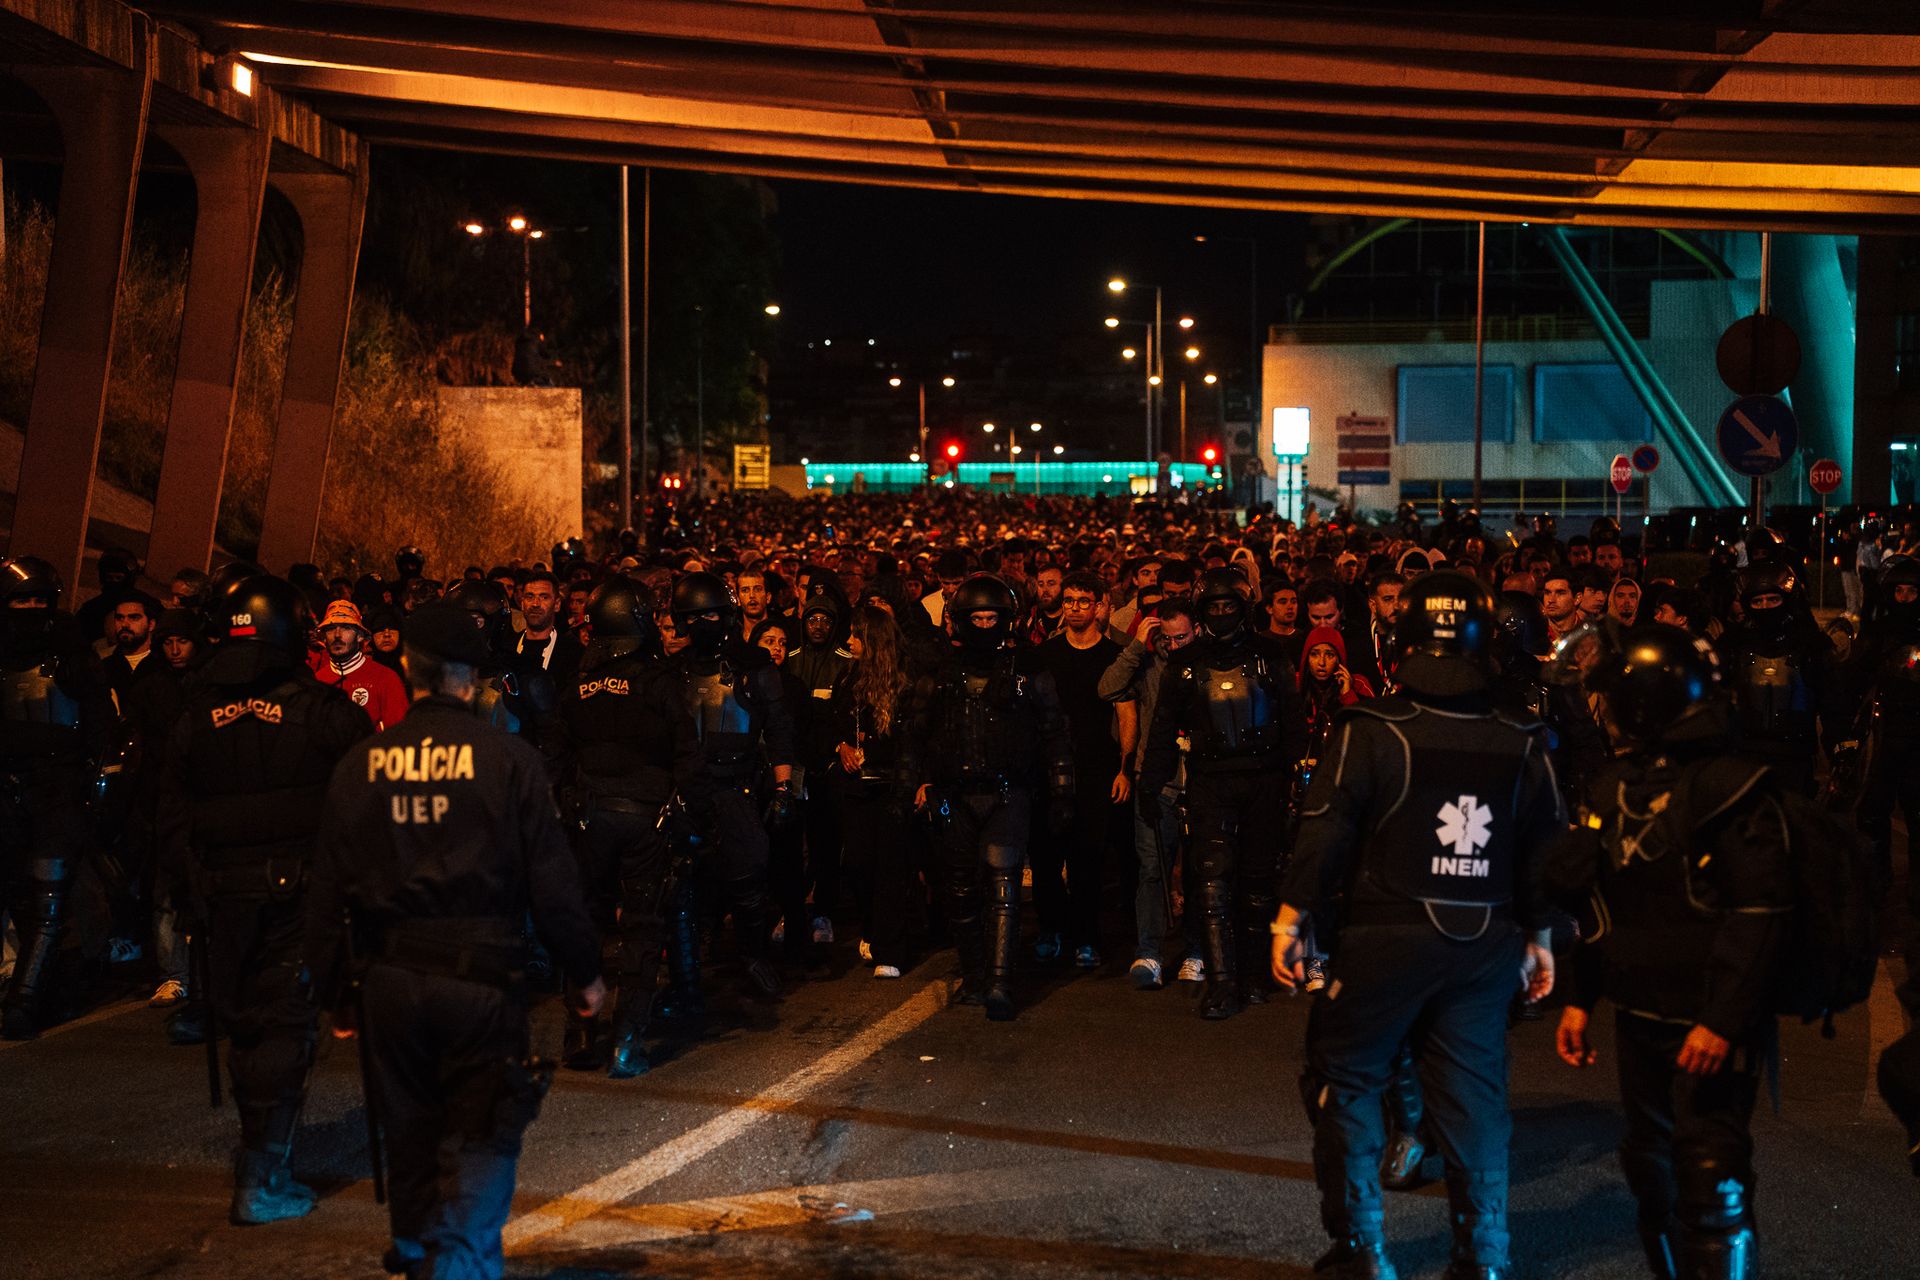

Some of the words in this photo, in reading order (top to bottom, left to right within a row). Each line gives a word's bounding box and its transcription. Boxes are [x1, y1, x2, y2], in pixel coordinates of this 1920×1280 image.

[1812, 470, 1842, 484] STOP
[1425, 597, 1467, 611] INEM
[231, 613, 252, 625] 160
[1436, 612, 1455, 625] 4.1
[368, 736, 475, 783] POLÍCIA
[391, 794, 450, 825] UEP
[1431, 856, 1490, 877] INEM
